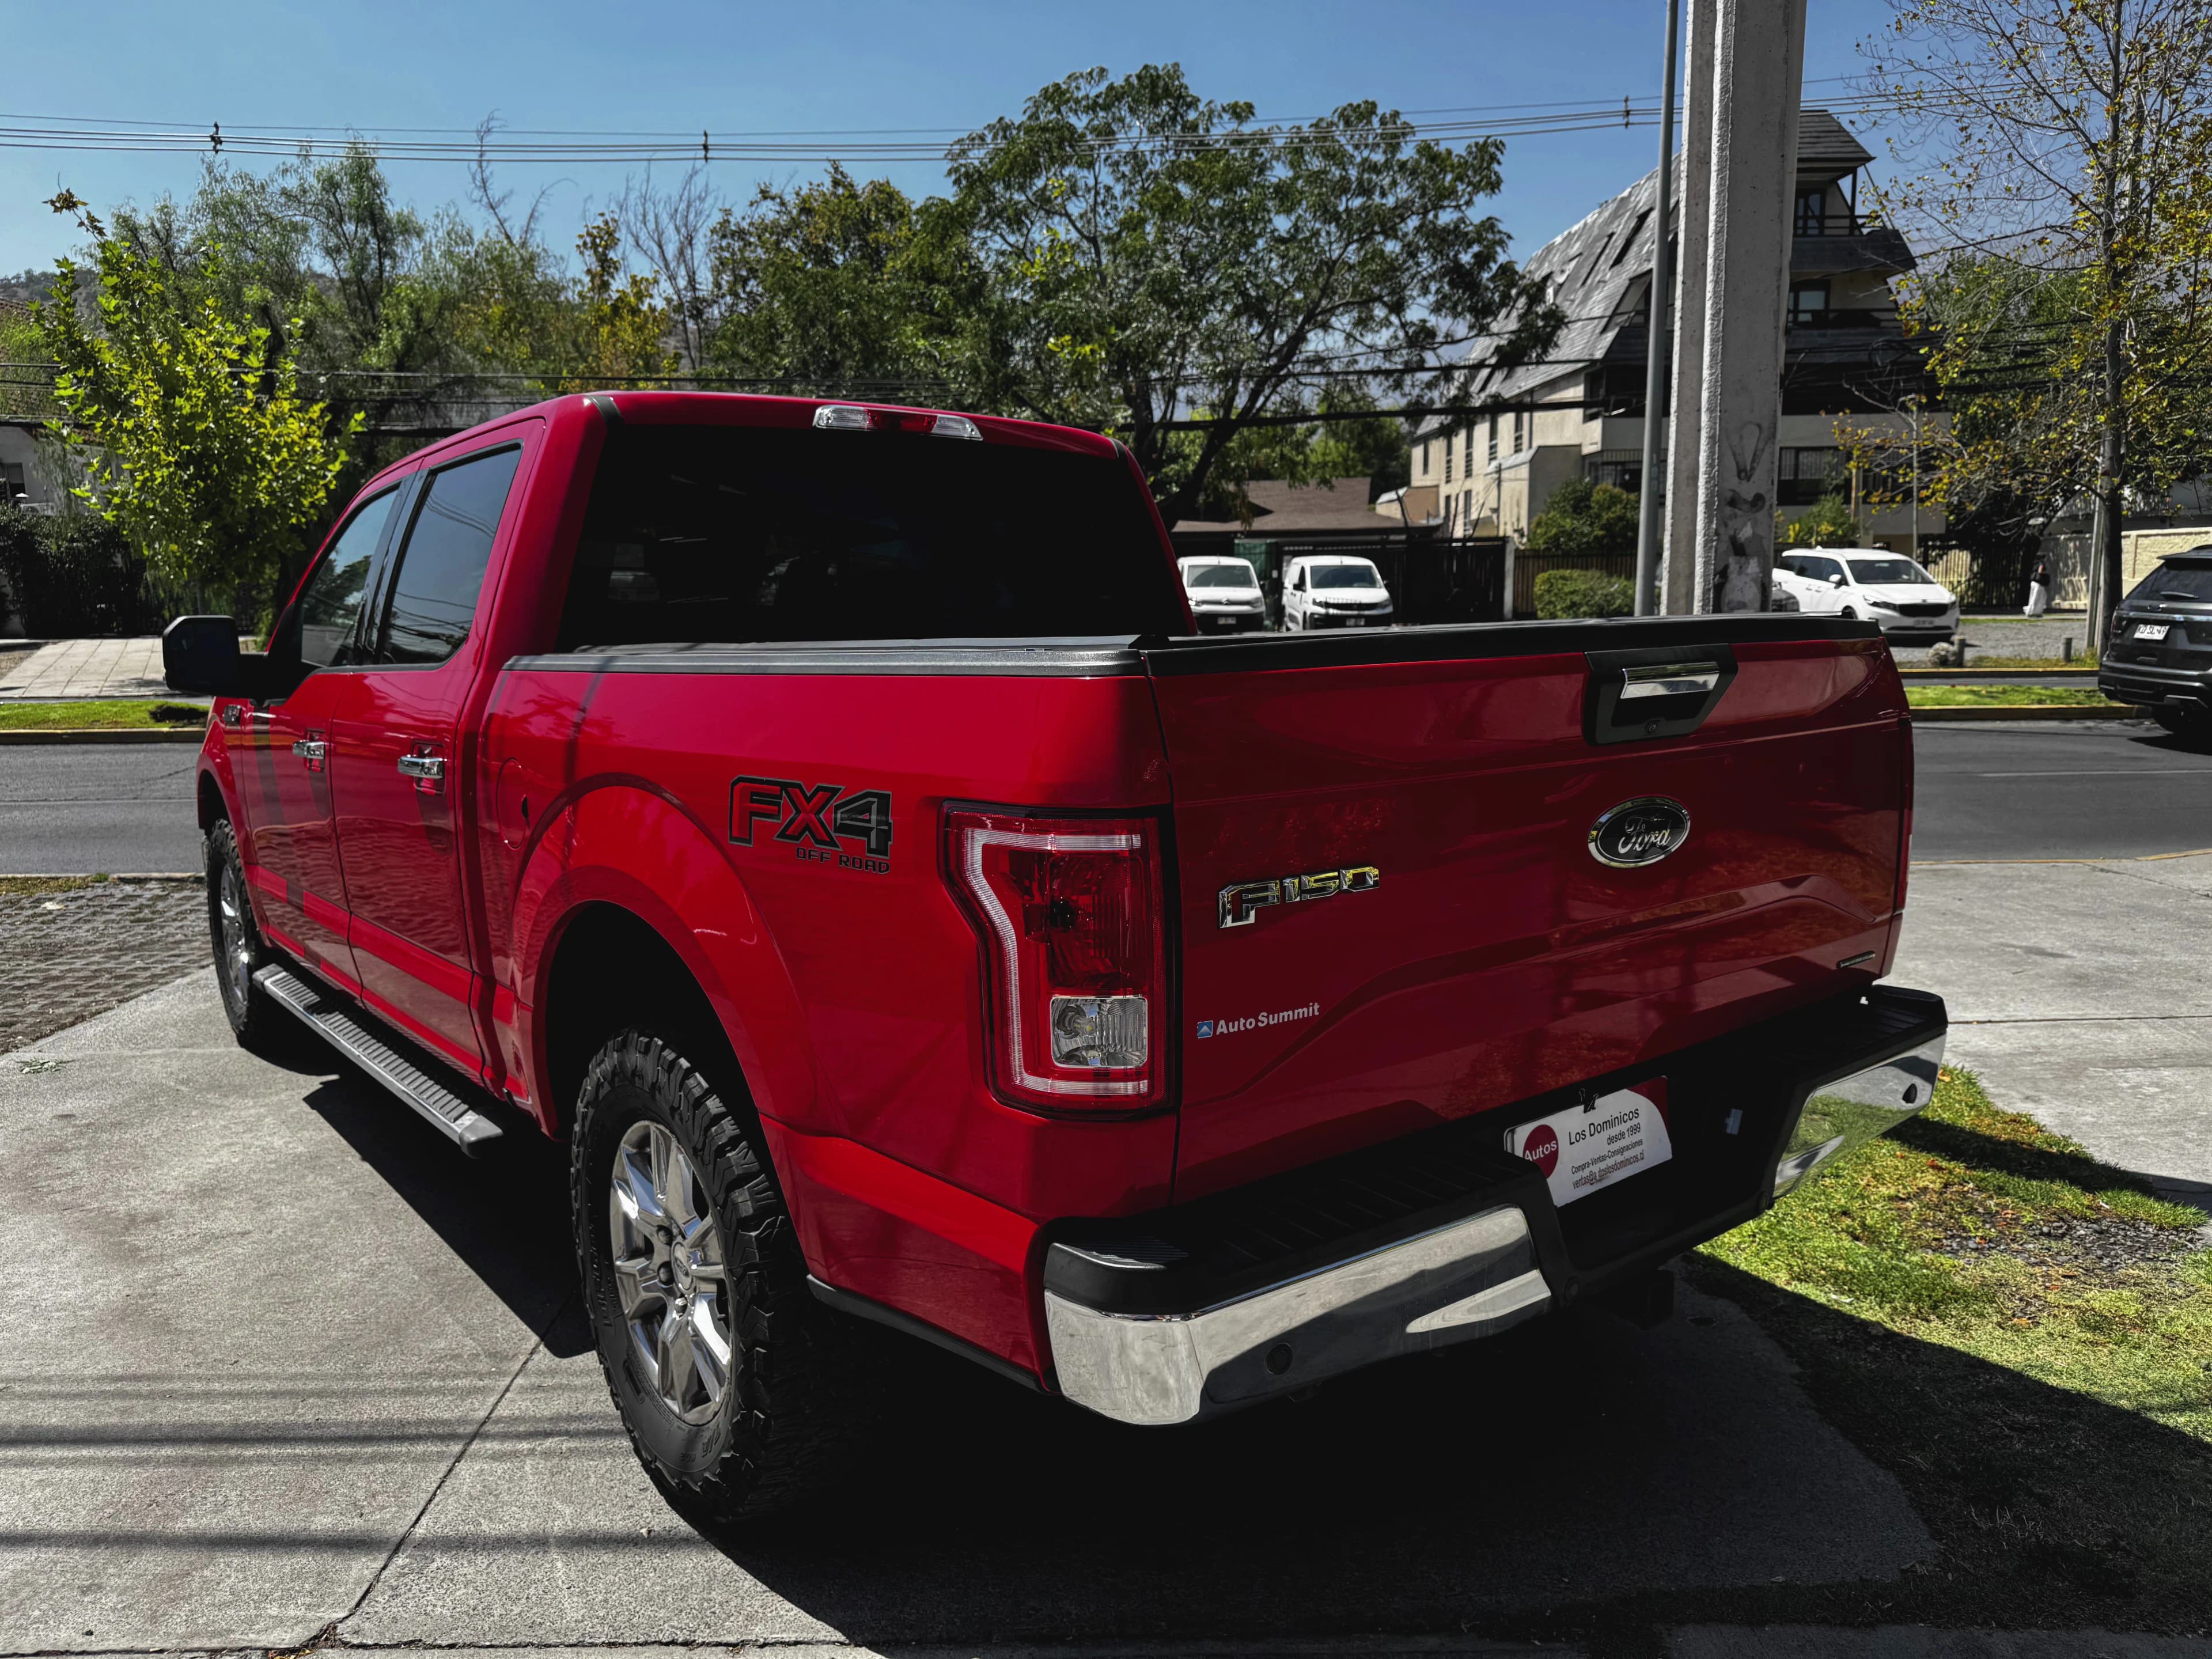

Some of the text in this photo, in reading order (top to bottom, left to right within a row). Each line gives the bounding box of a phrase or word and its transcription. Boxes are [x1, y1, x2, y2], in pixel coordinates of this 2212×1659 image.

[729, 775, 893, 859] FX4
[1618, 816, 1672, 854] Ford
[796, 847, 890, 874] OFF ROAD
[1568, 1108, 1640, 1145] Los Dominicos
[1607, 1123, 1641, 1146] desde 1999
[1524, 1140, 1558, 1161] Autos
